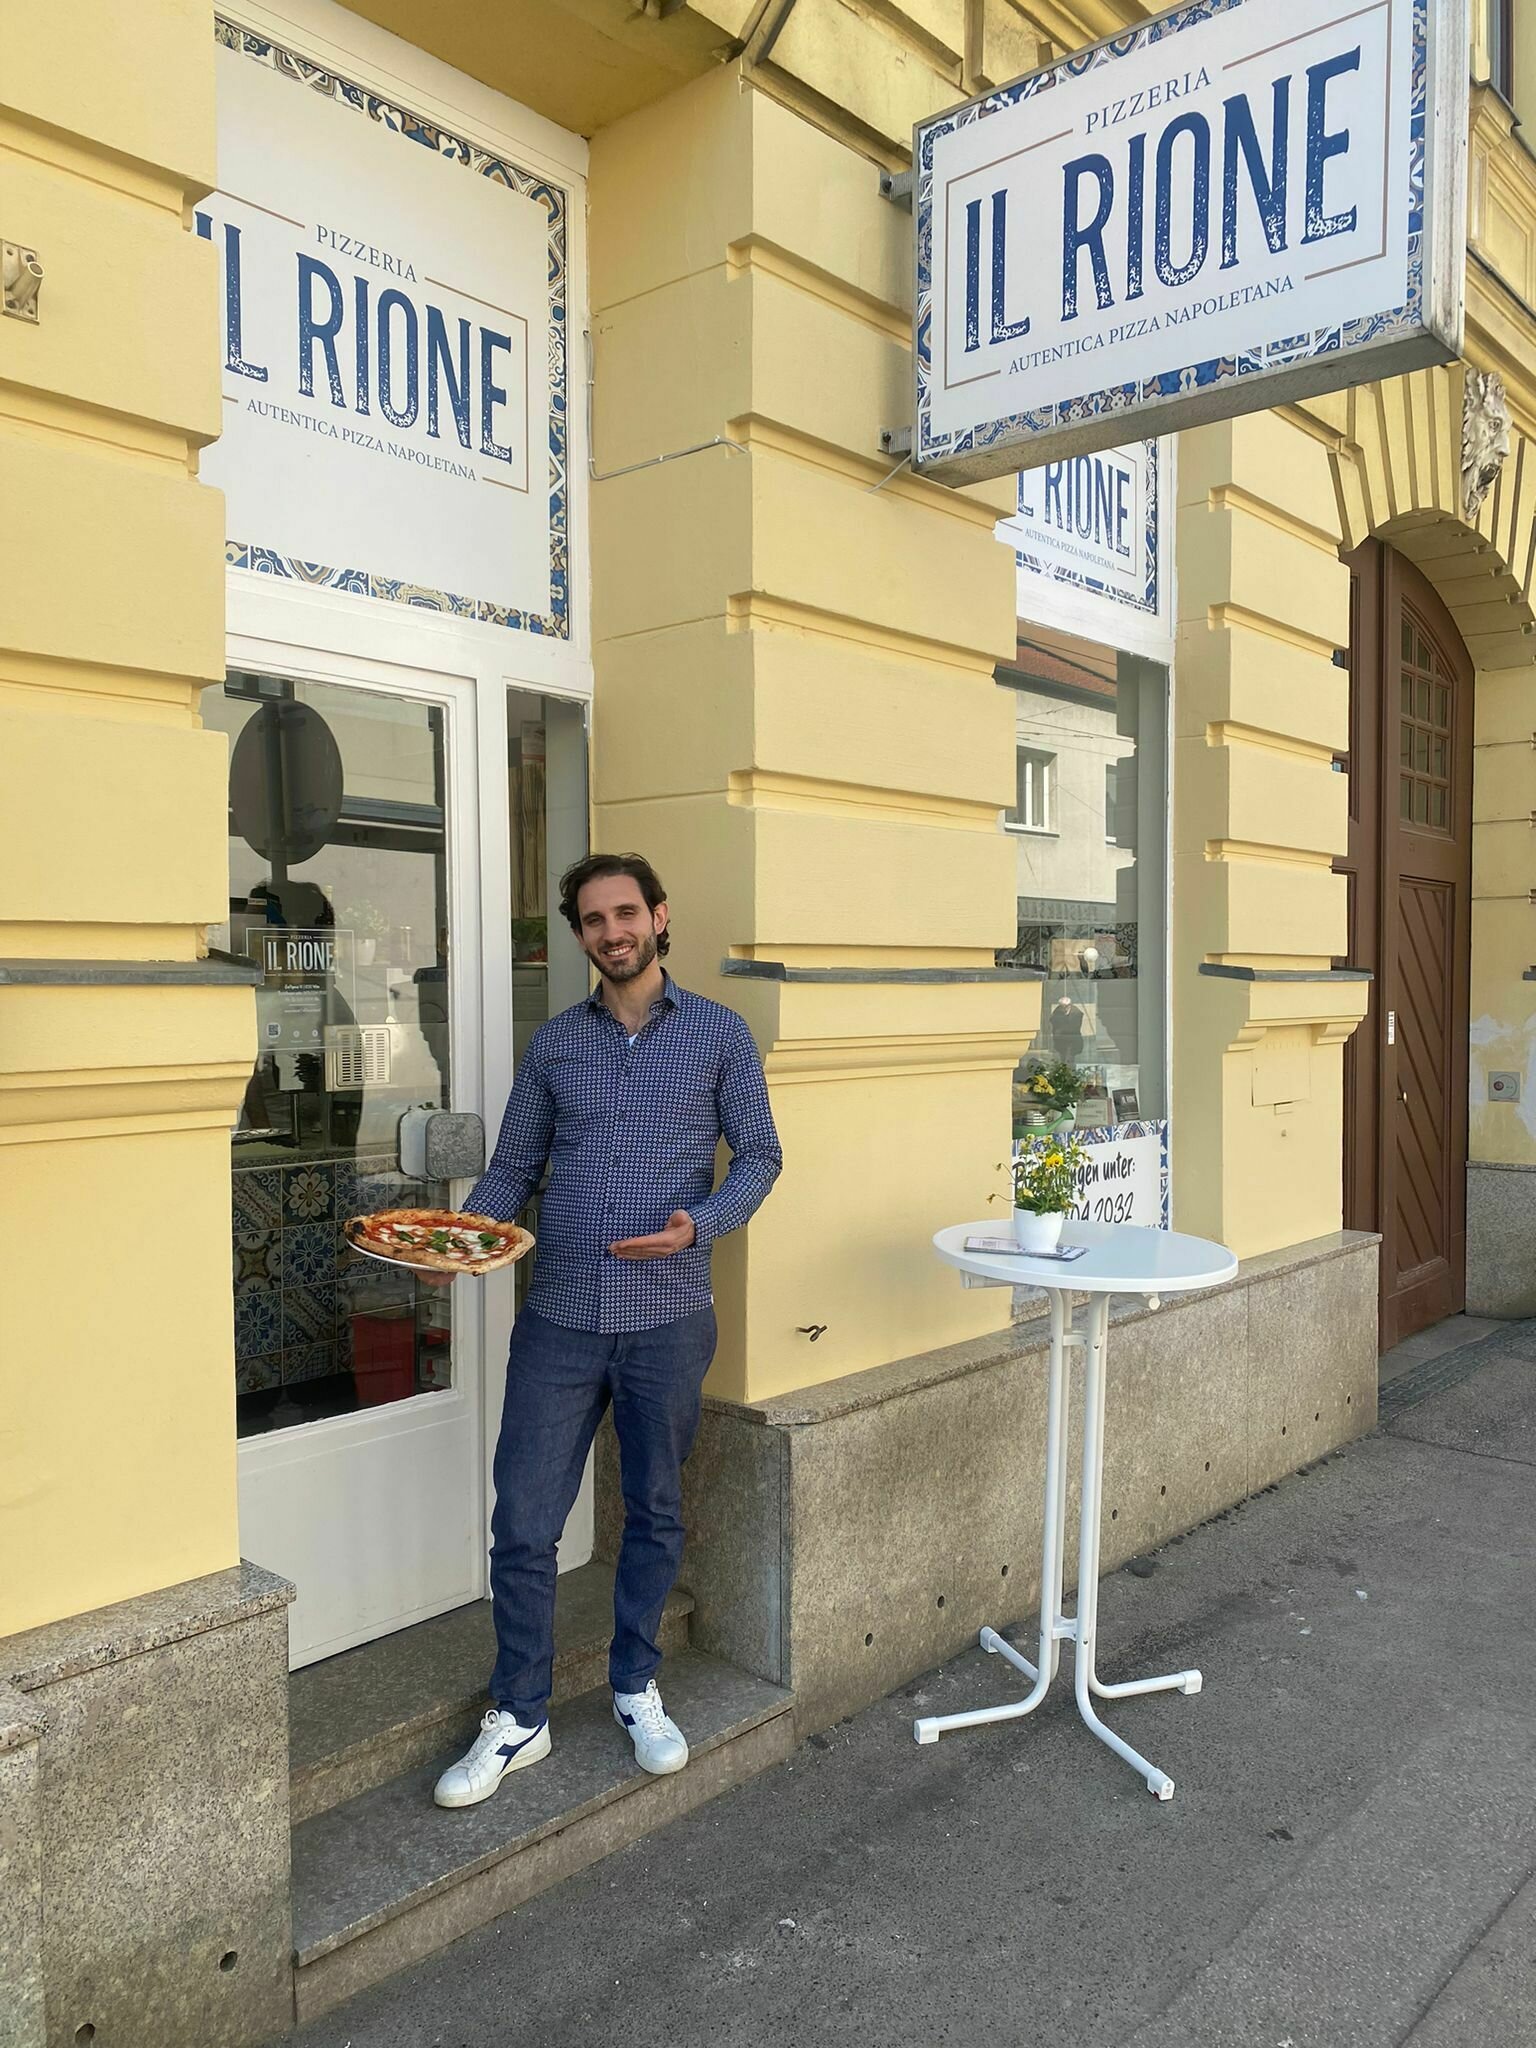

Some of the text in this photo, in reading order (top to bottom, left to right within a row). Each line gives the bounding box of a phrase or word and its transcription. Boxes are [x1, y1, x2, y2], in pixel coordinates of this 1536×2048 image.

[1086, 66, 1212, 135] PIZZERIA
[964, 44, 1361, 353] IL RIONE
[316, 224, 418, 283] PIZZERIA
[195, 211, 512, 464] L RIONE
[1008, 274, 1294, 375] AUTENTICA PIZZA NAPOLETANA
[247, 399, 477, 481] AUTENTICA PIZZA NAPOLETANA
[1044, 454, 1130, 558] RIONE
[267, 941, 335, 971] IL RIONE
[1103, 1152, 1136, 1181] unter:
[1094, 1192, 1134, 1224] 2032
